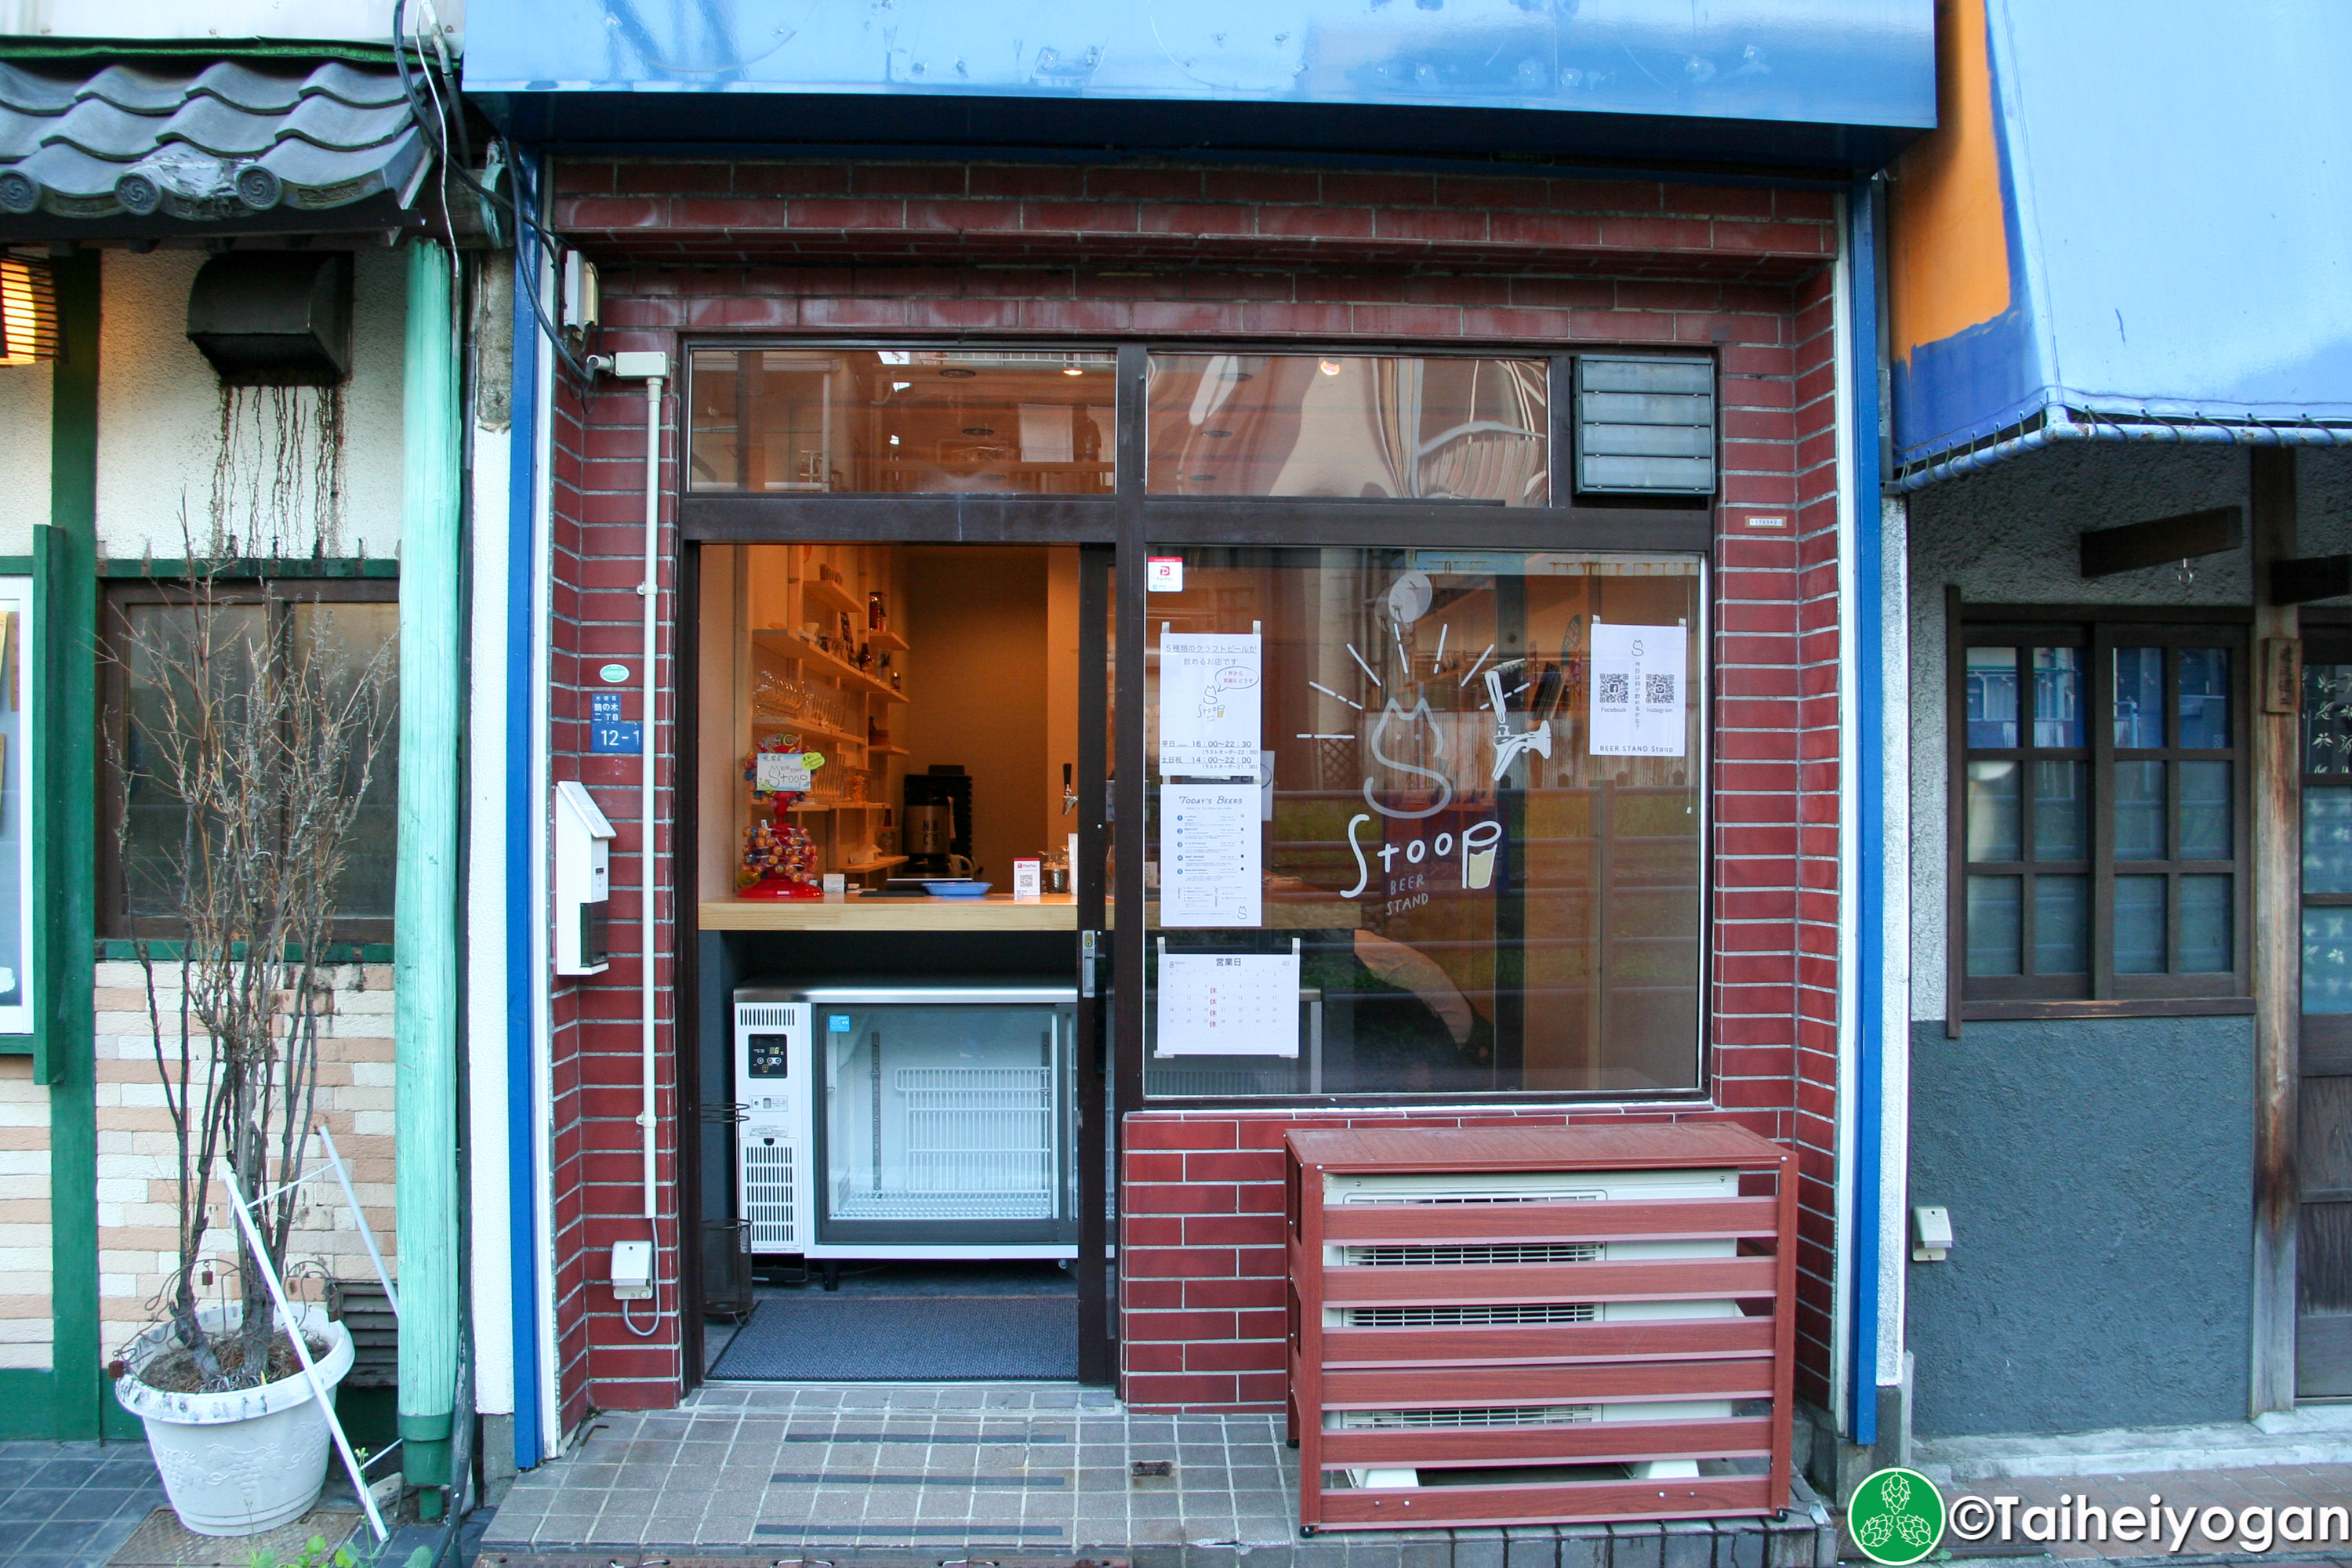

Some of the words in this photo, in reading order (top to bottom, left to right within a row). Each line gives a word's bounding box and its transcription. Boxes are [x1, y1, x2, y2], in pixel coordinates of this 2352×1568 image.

[1340, 813, 1501, 898] Stoop
[1390, 874, 1425, 895] BEER
[1386, 892, 1429, 916] STAND
[1216, 958, 1242, 967] 営業日
